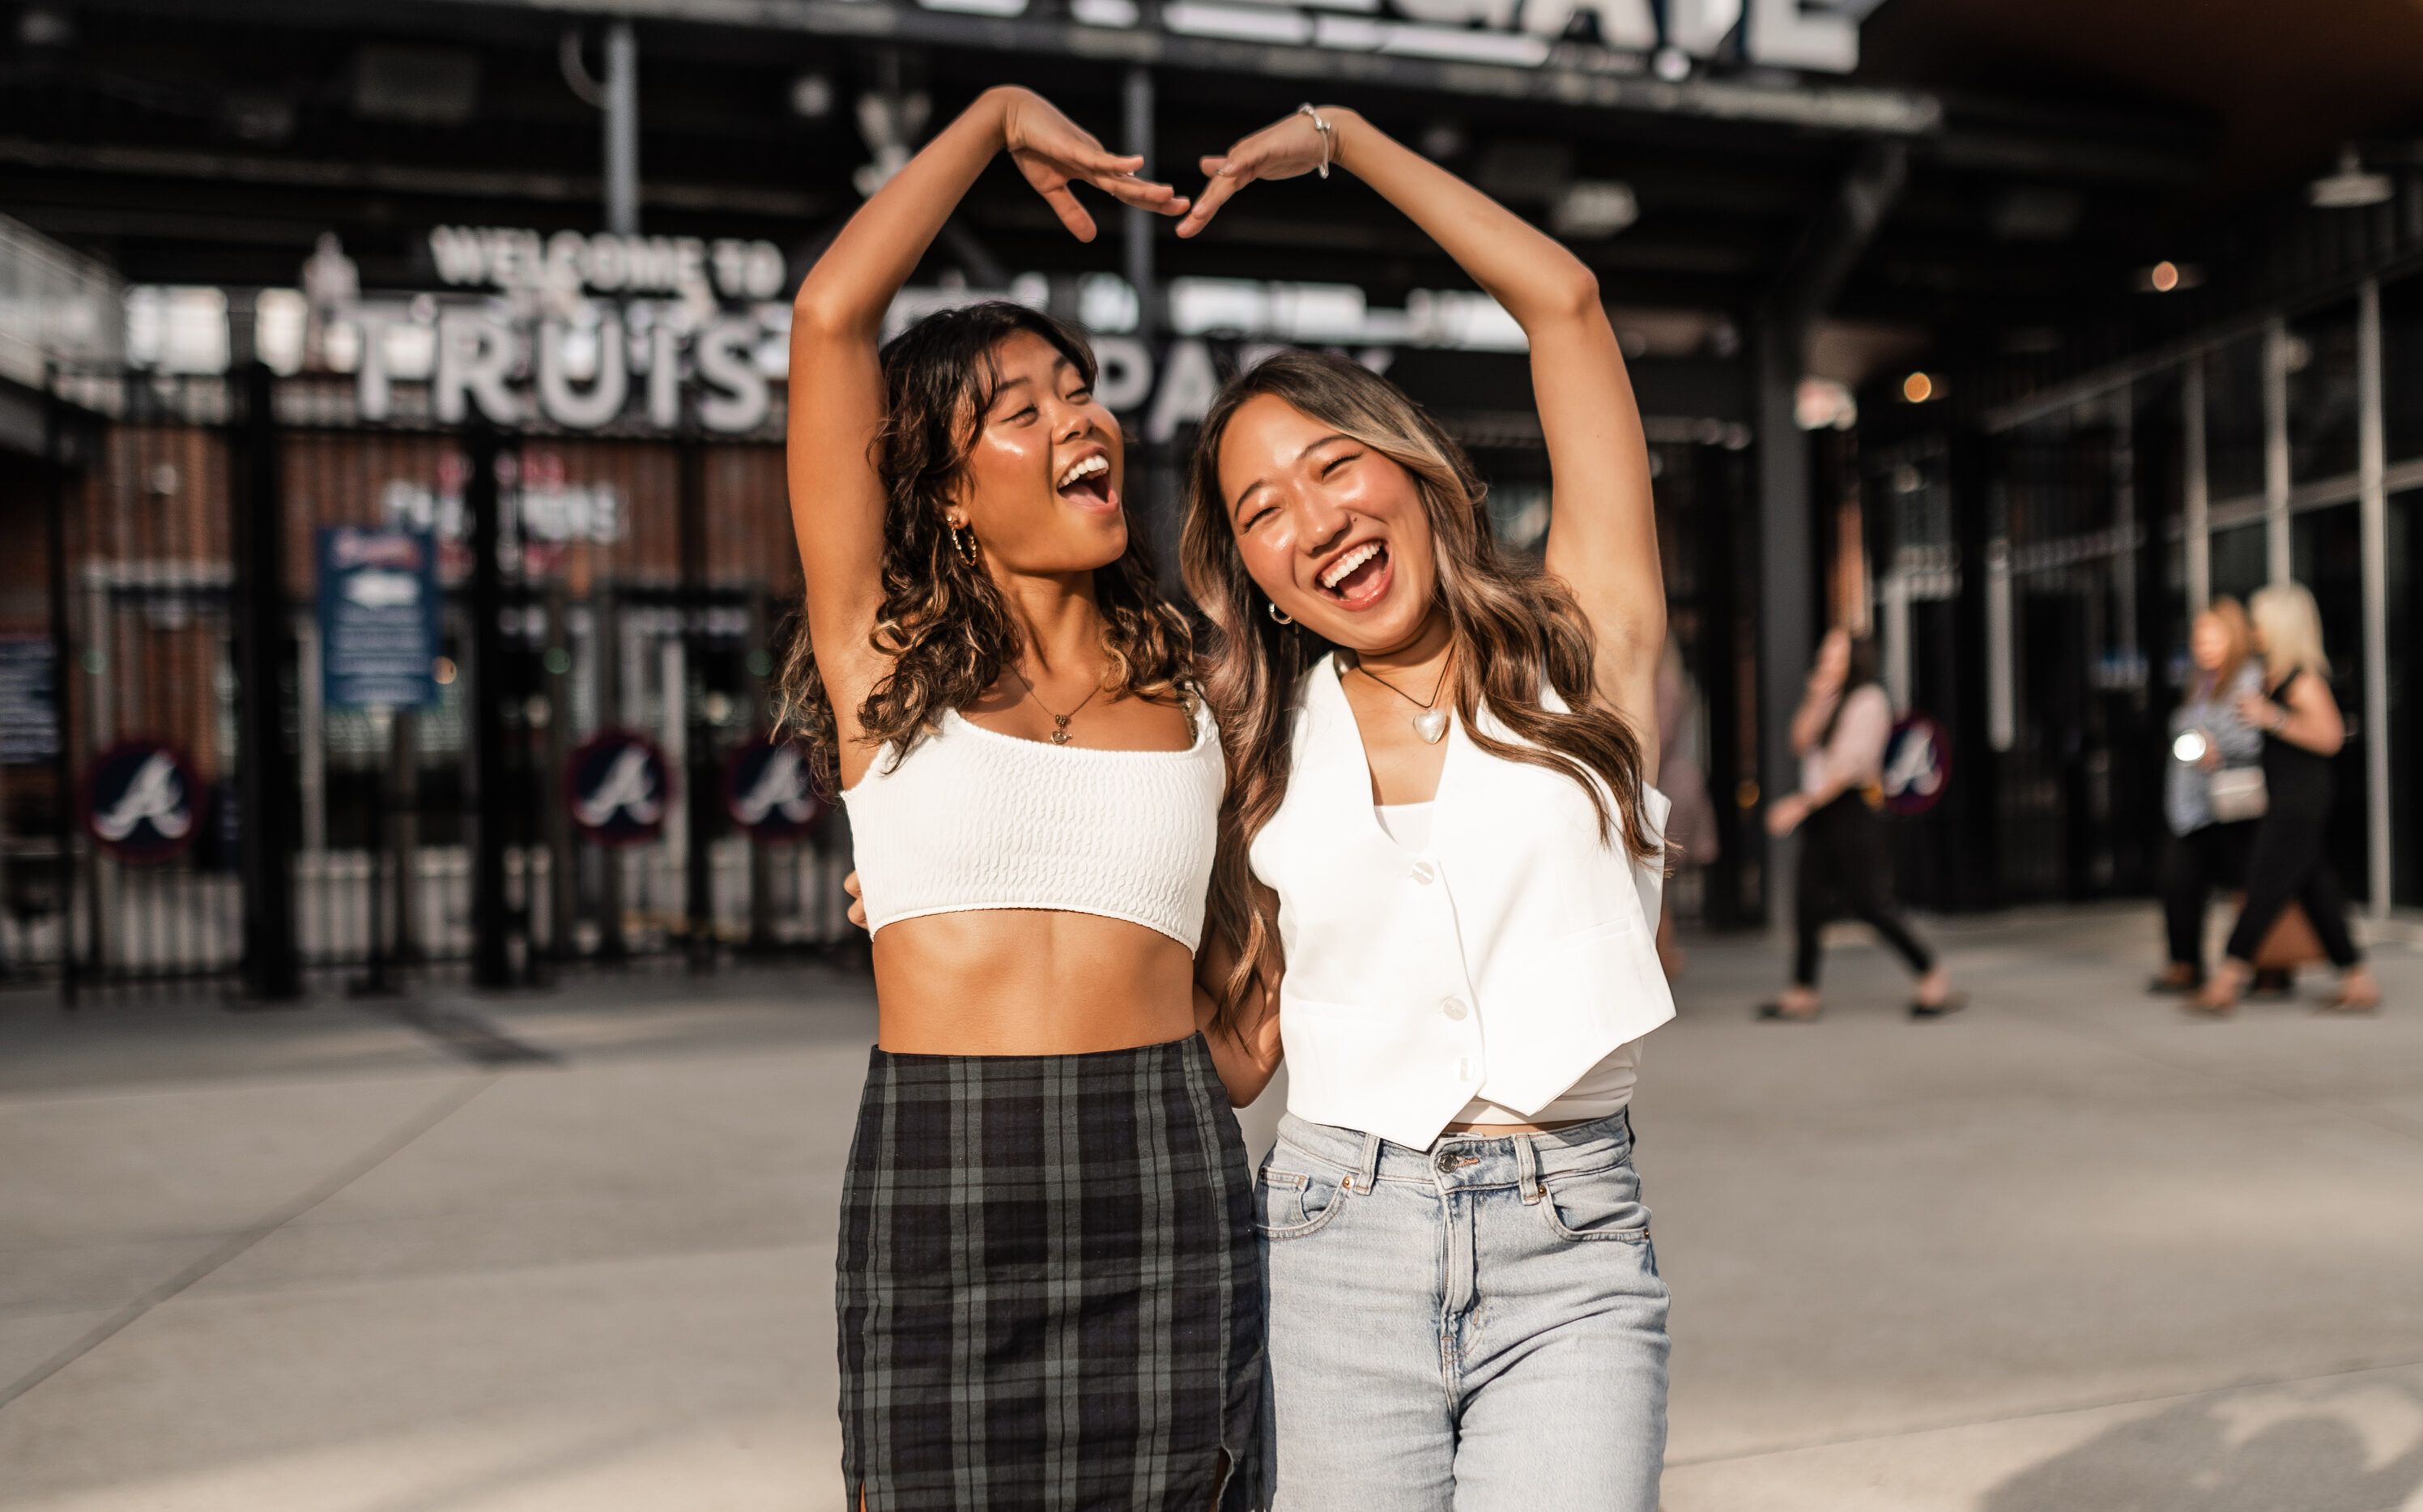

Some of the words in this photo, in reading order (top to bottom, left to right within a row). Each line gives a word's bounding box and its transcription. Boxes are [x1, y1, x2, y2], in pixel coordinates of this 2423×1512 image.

[429, 224, 705, 287] WELCOME
[714, 240, 786, 300] TO
[335, 303, 790, 434] TRUIS
